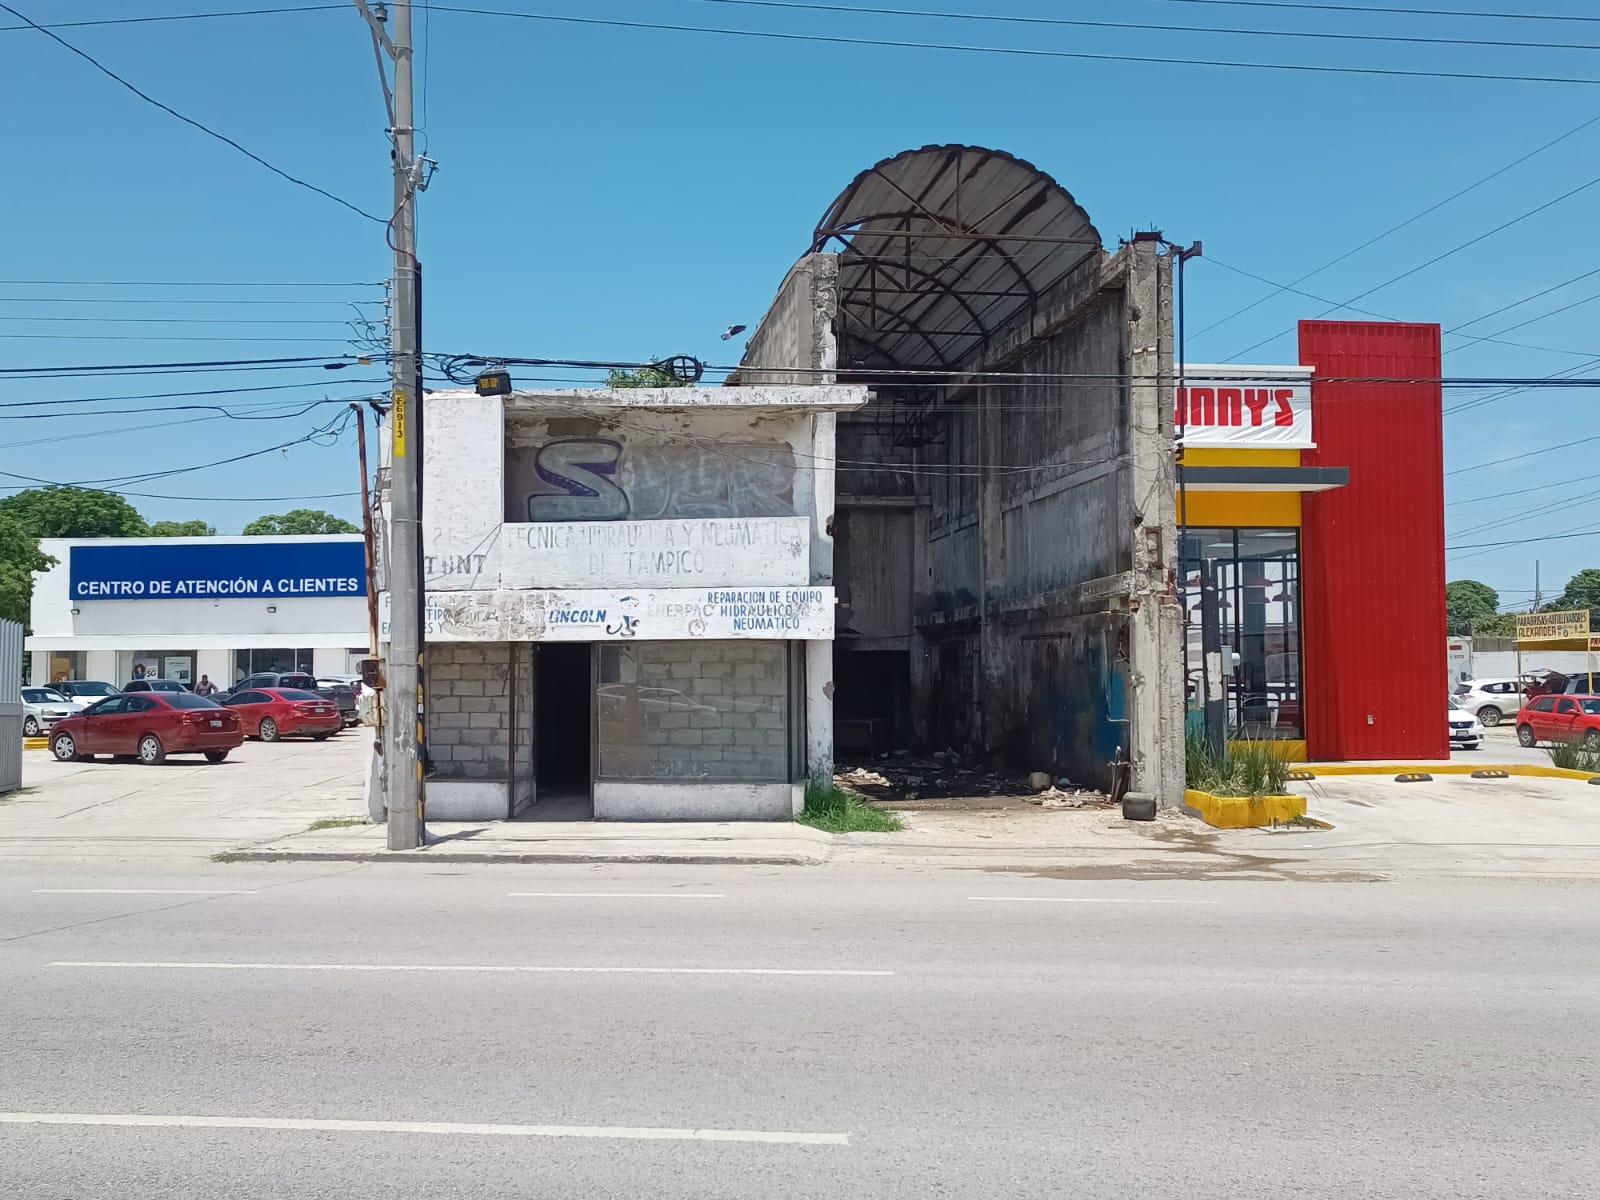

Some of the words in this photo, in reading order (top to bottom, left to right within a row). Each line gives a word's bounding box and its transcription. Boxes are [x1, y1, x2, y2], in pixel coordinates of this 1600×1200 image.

[77, 580, 144, 595] CENTRO
[150, 580, 171, 594] DE
[175, 577, 257, 593] ATENCIÓN
[262, 579, 274, 592] A
[278, 577, 358, 592] CLIENTES
[708, 591, 765, 604] REPARACION
[769, 591, 781, 603] DE
[786, 590, 822, 603] EQUIPO
[720, 604, 793, 617] HIDRAULICO
[734, 617, 799, 630] NEUMATICO
[1519, 626, 1556, 637] ALEXANDER
